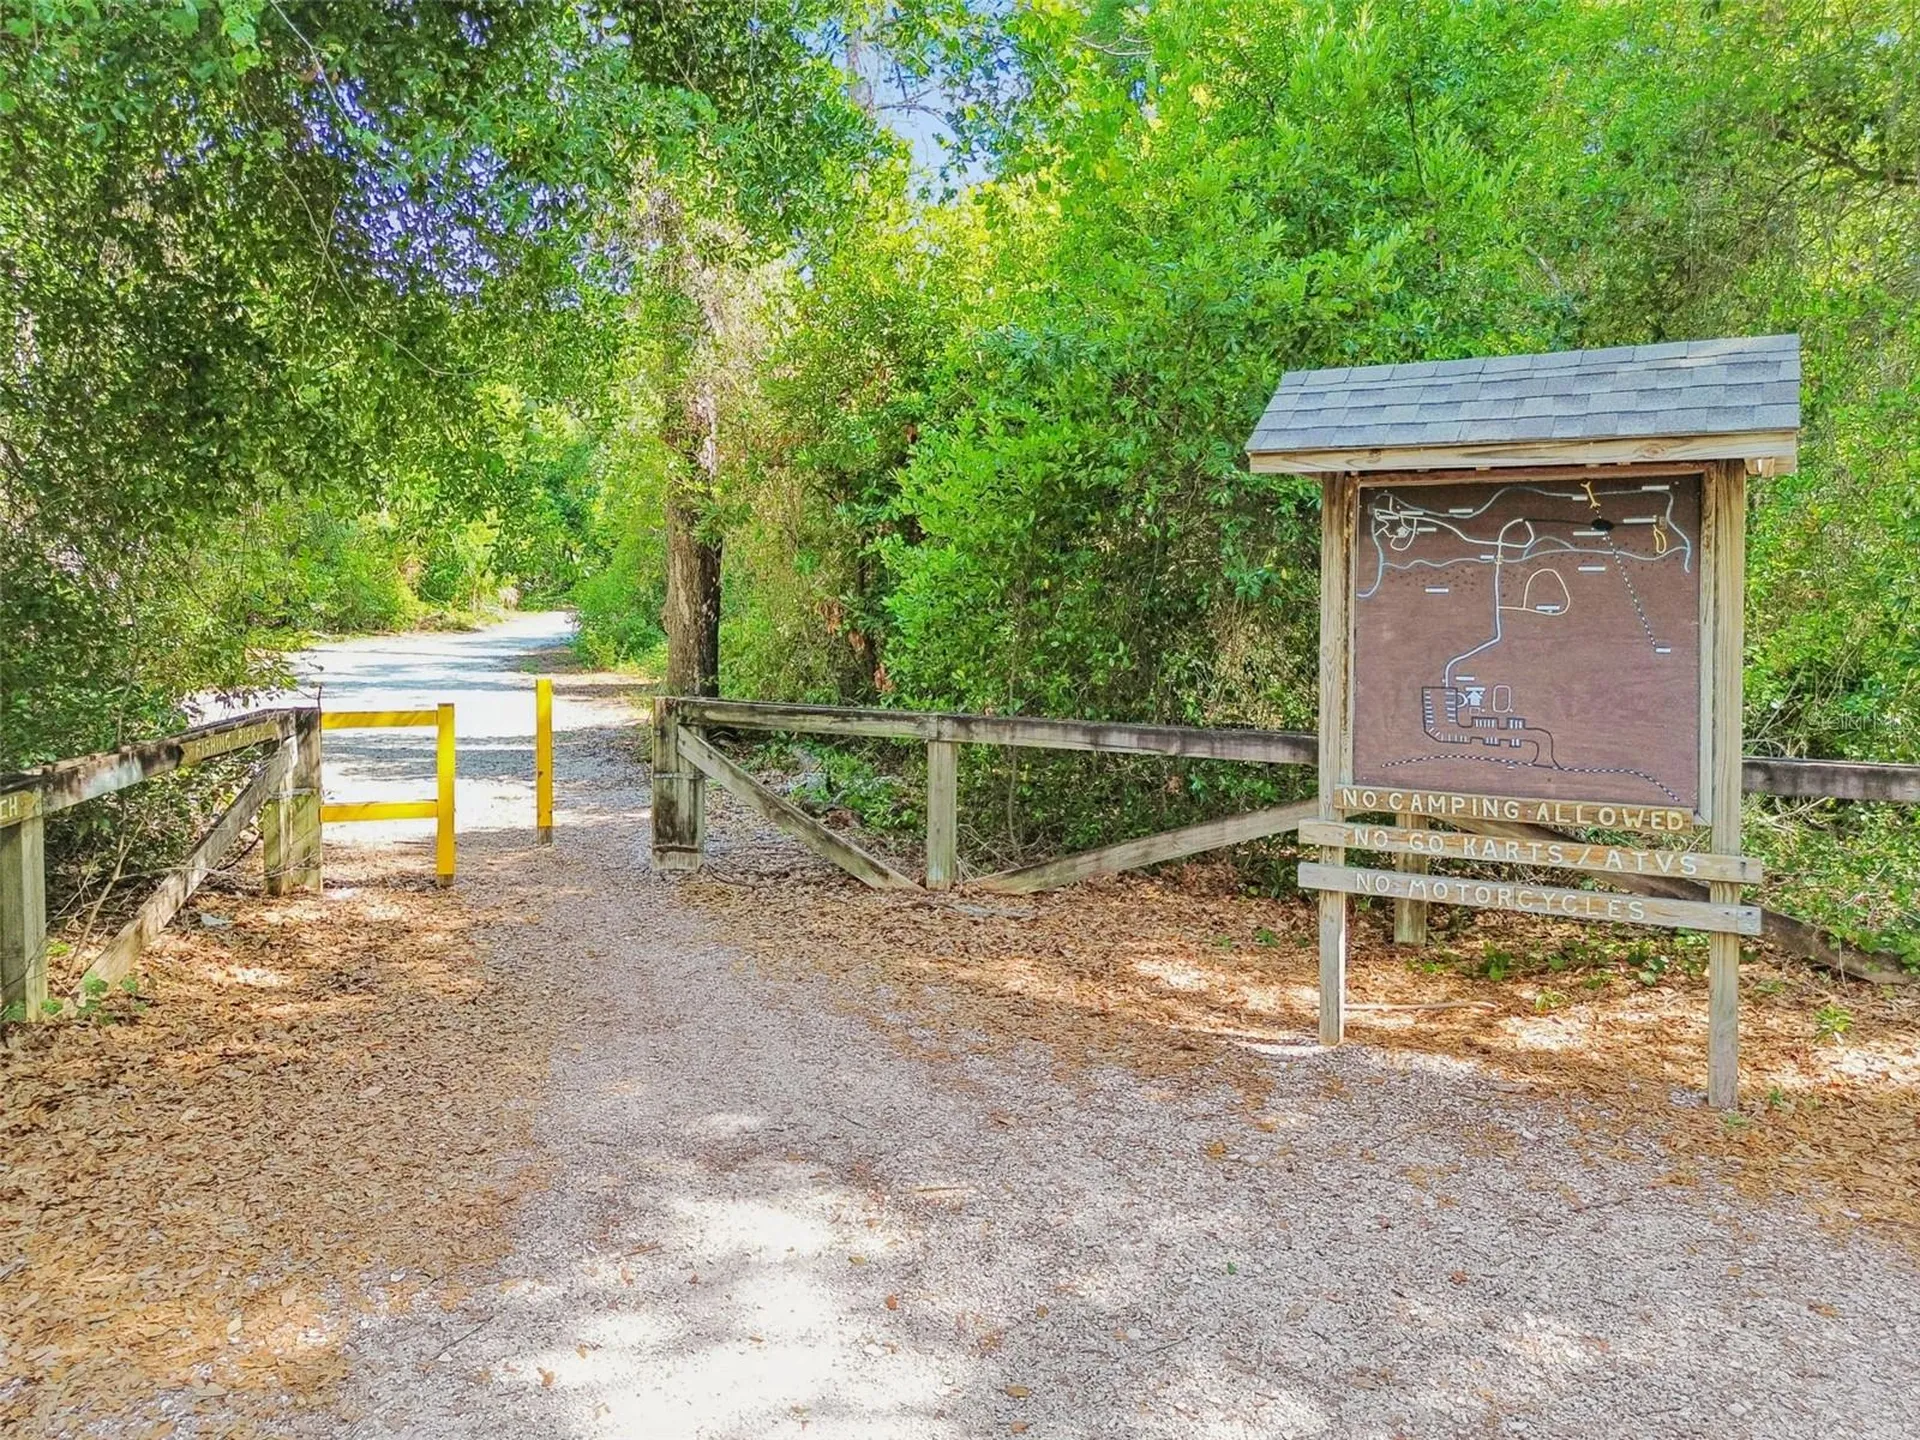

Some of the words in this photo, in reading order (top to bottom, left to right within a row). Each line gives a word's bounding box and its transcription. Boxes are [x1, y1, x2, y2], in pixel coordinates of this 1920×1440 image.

[195, 733, 230, 753] FISHING
[1342, 788, 1377, 808] NO
[1389, 792, 1520, 819] CAMPING
[1536, 802, 1684, 831] ALLOWED
[1354, 828, 1389, 848] NO
[1409, 833, 1444, 851] GO
[1356, 873, 1391, 893] NO
[1408, 880, 1645, 921] MOTORCYCLES
